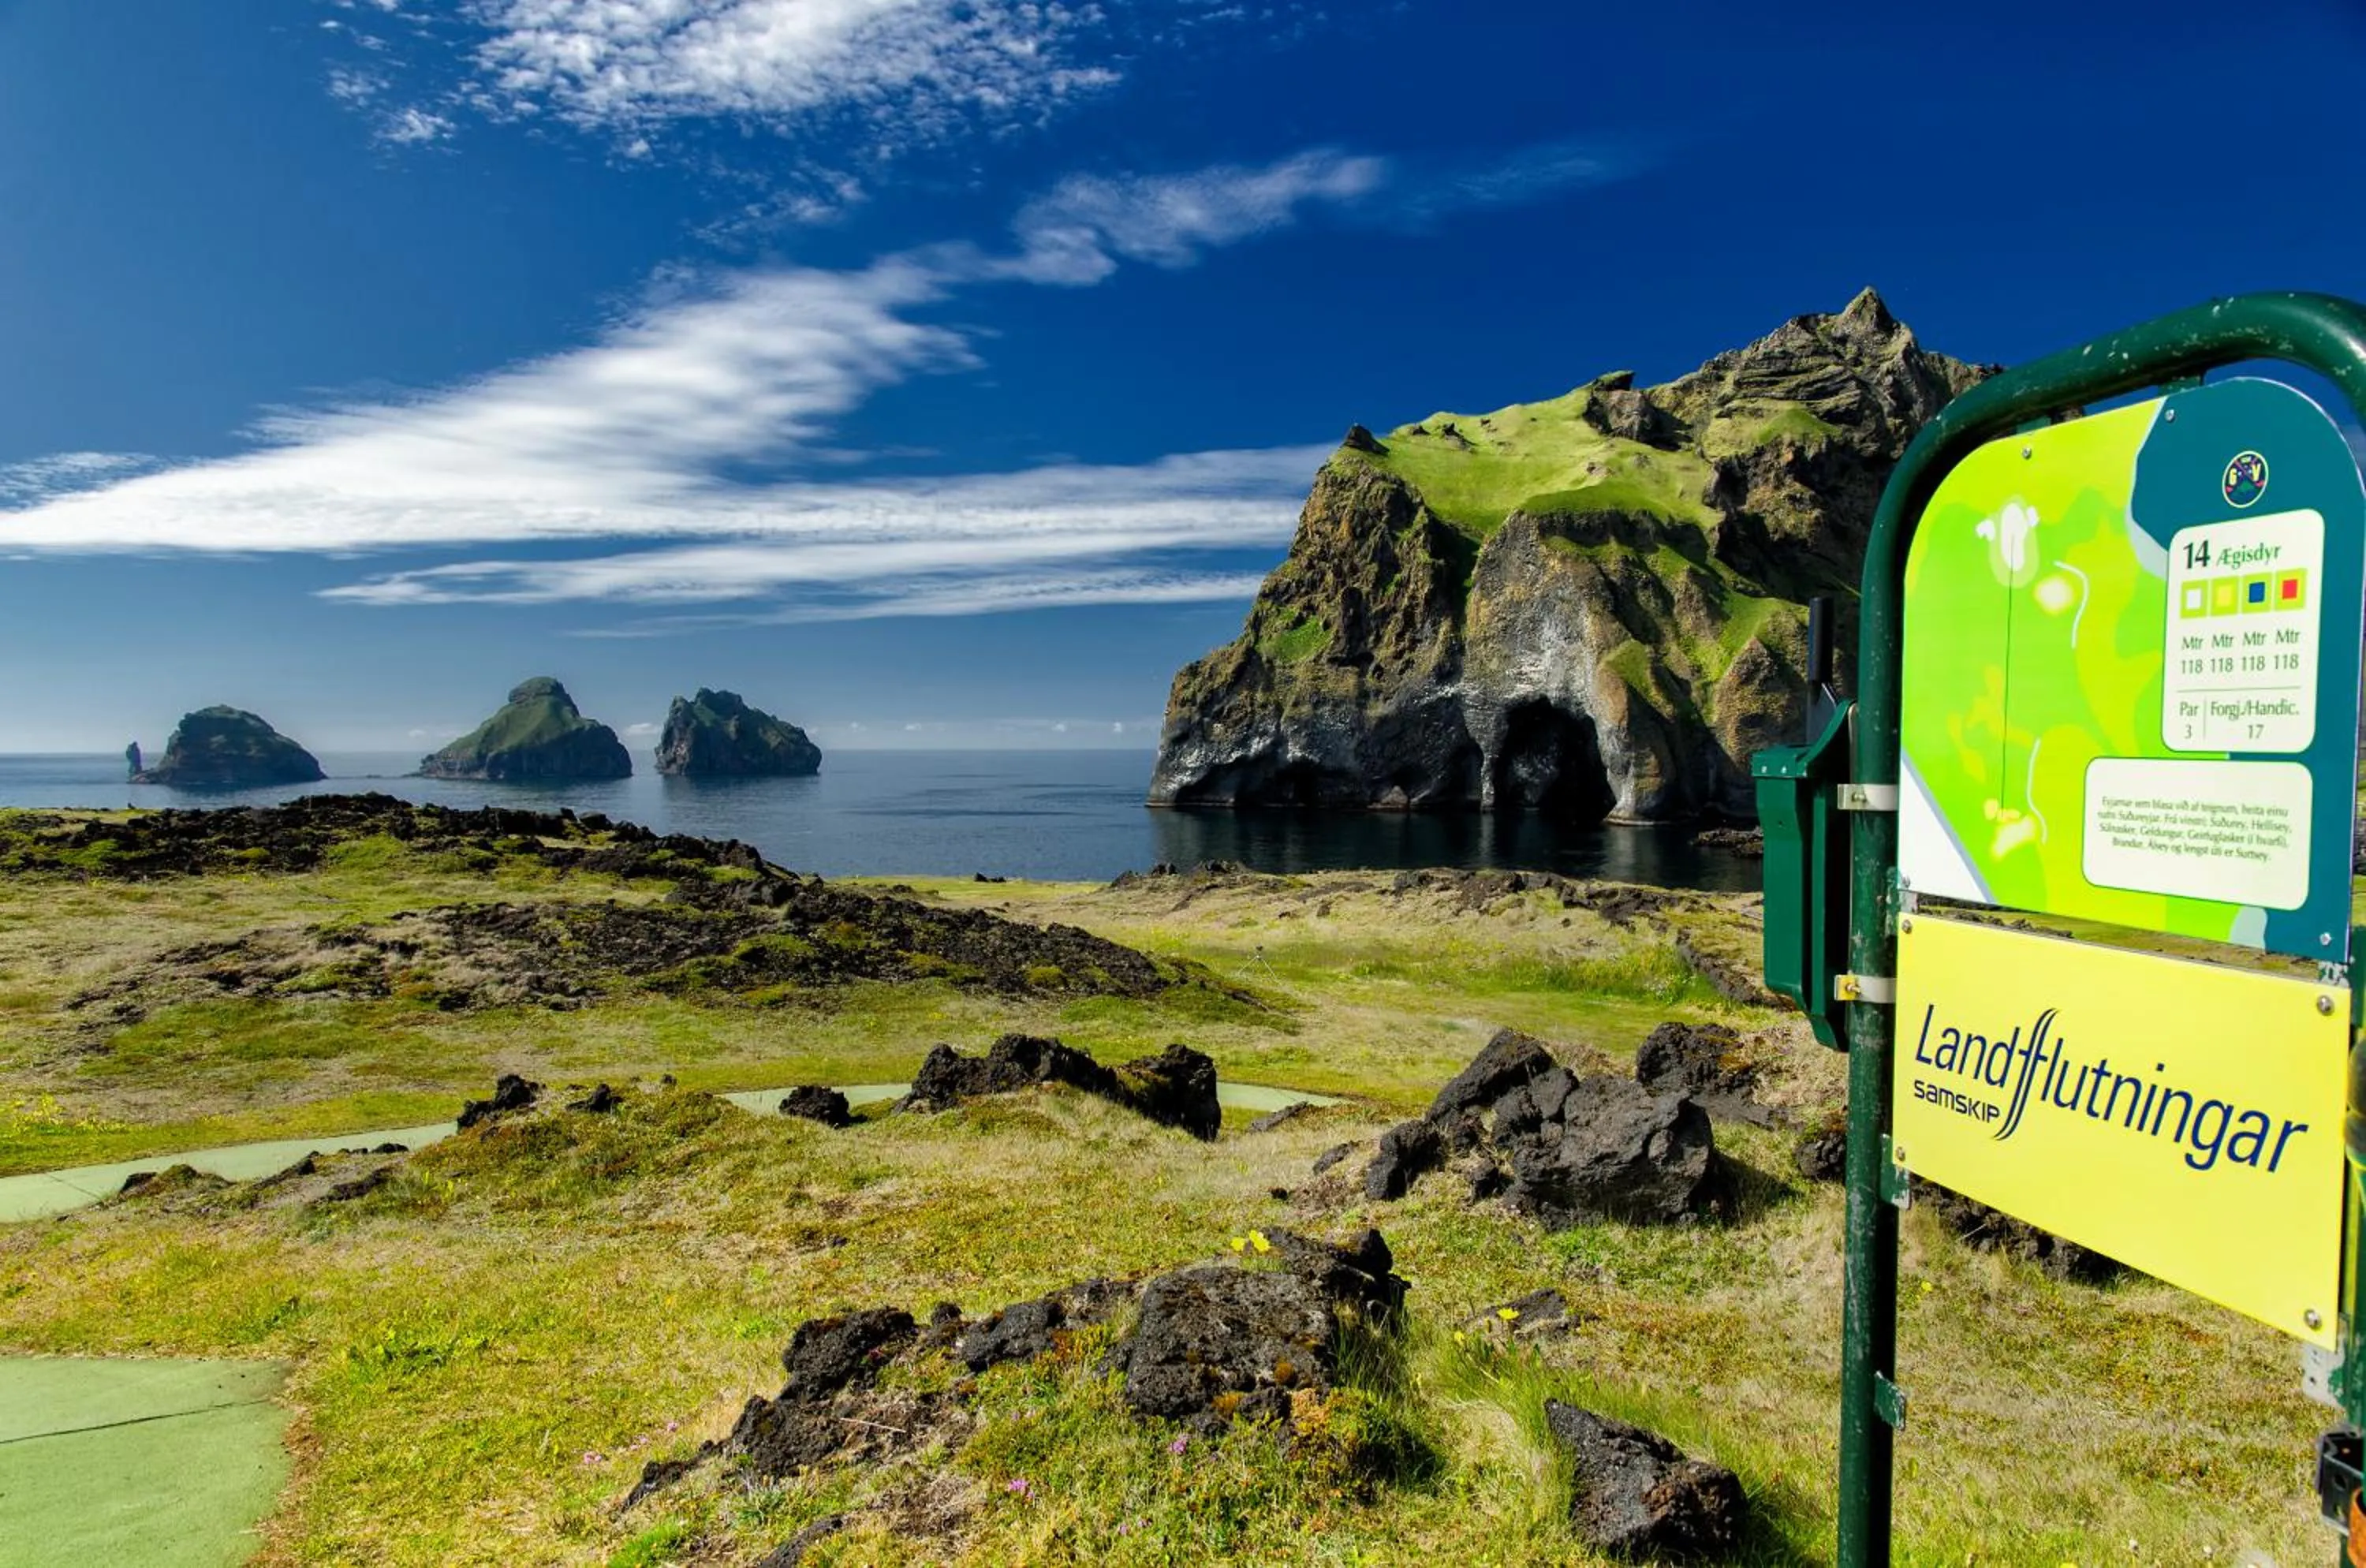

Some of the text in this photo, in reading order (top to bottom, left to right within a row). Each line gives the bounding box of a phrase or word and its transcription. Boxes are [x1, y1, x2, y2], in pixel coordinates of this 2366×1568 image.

[2183, 539, 2281, 571] 14 Ægisdyr
[2181, 629, 2300, 651] Mtr Mtr Mtr Mtr
[2181, 654, 2298, 674] 118 118 118 118
[2179, 701, 2199, 717] Par
[2185, 724, 2264, 739] 3 17
